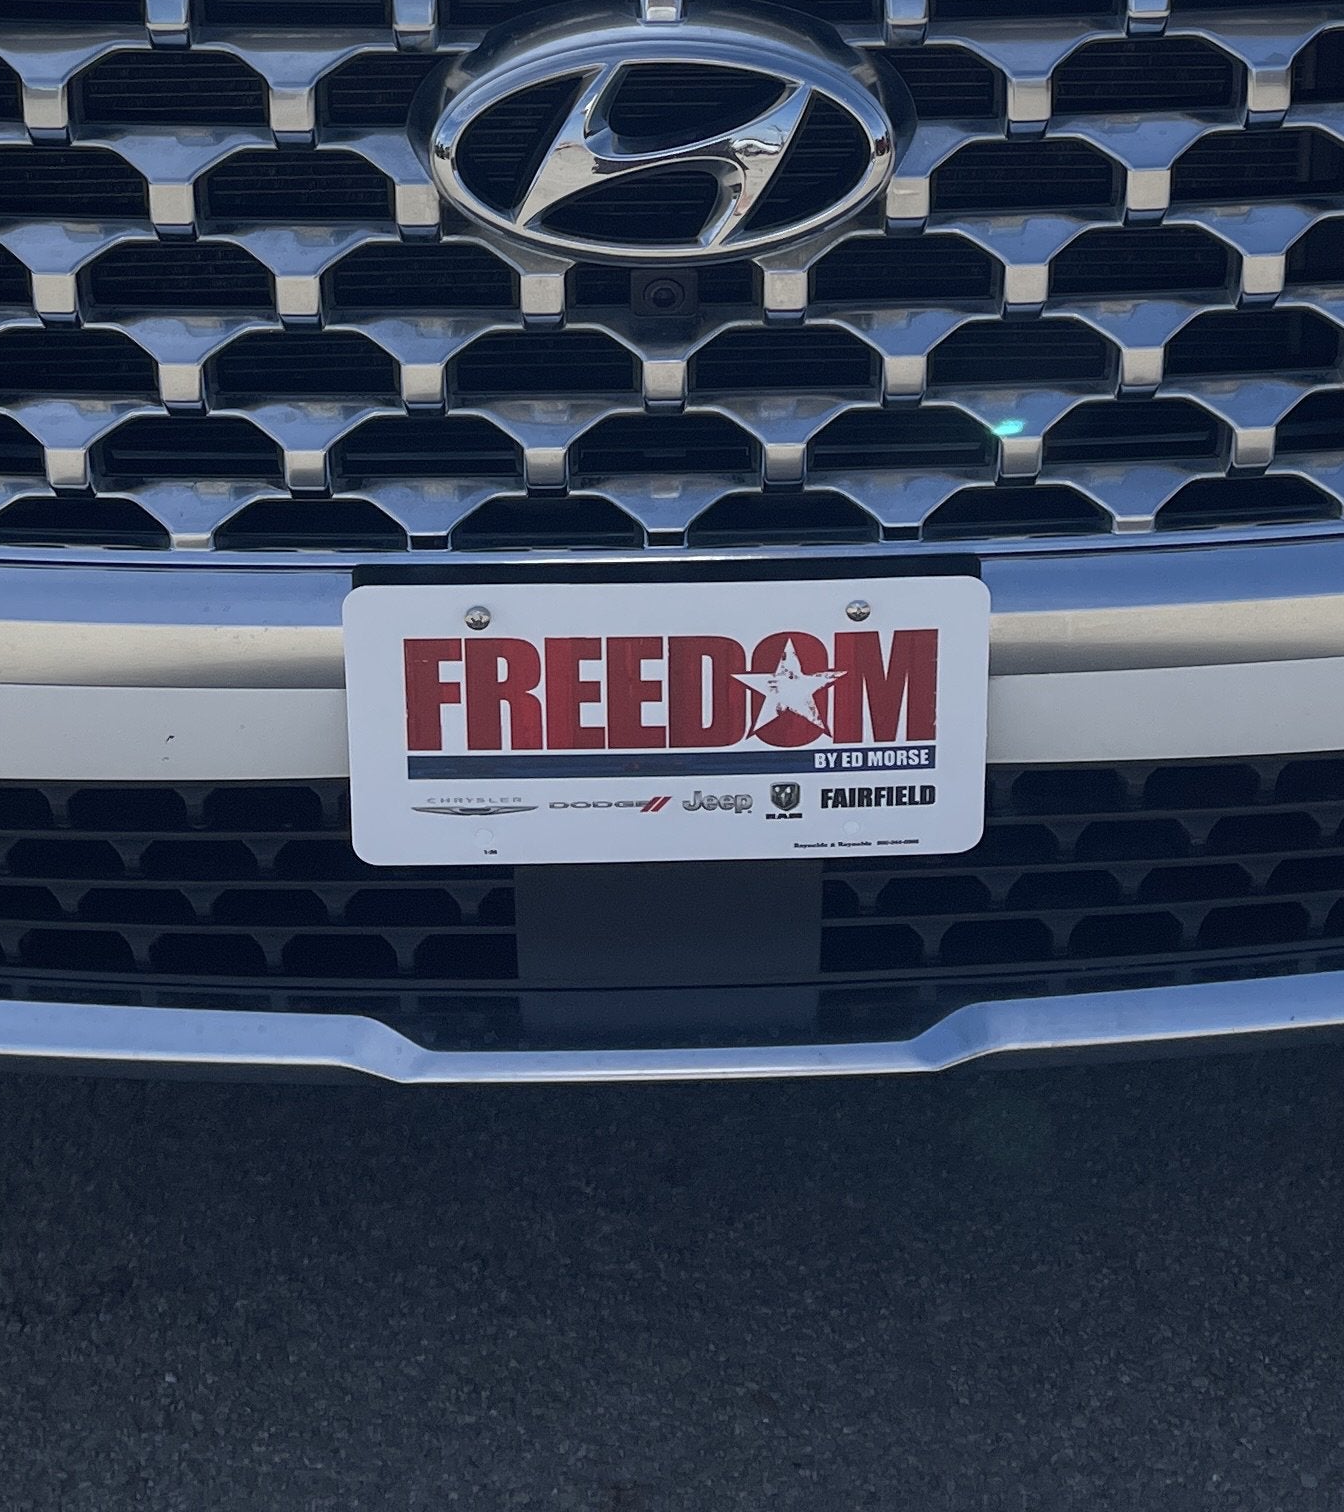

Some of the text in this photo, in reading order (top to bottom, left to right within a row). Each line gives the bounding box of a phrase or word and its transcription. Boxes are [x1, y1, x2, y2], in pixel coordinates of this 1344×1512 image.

[403, 629, 940, 751] FREEDOM
[813, 749, 930, 769] BY ED MORSE
[427, 796, 523, 805] CHRYSLER
[549, 800, 647, 809] DODGE
[682, 790, 754, 814] Jeep
[820, 784, 937, 809] FAIRFIELD
